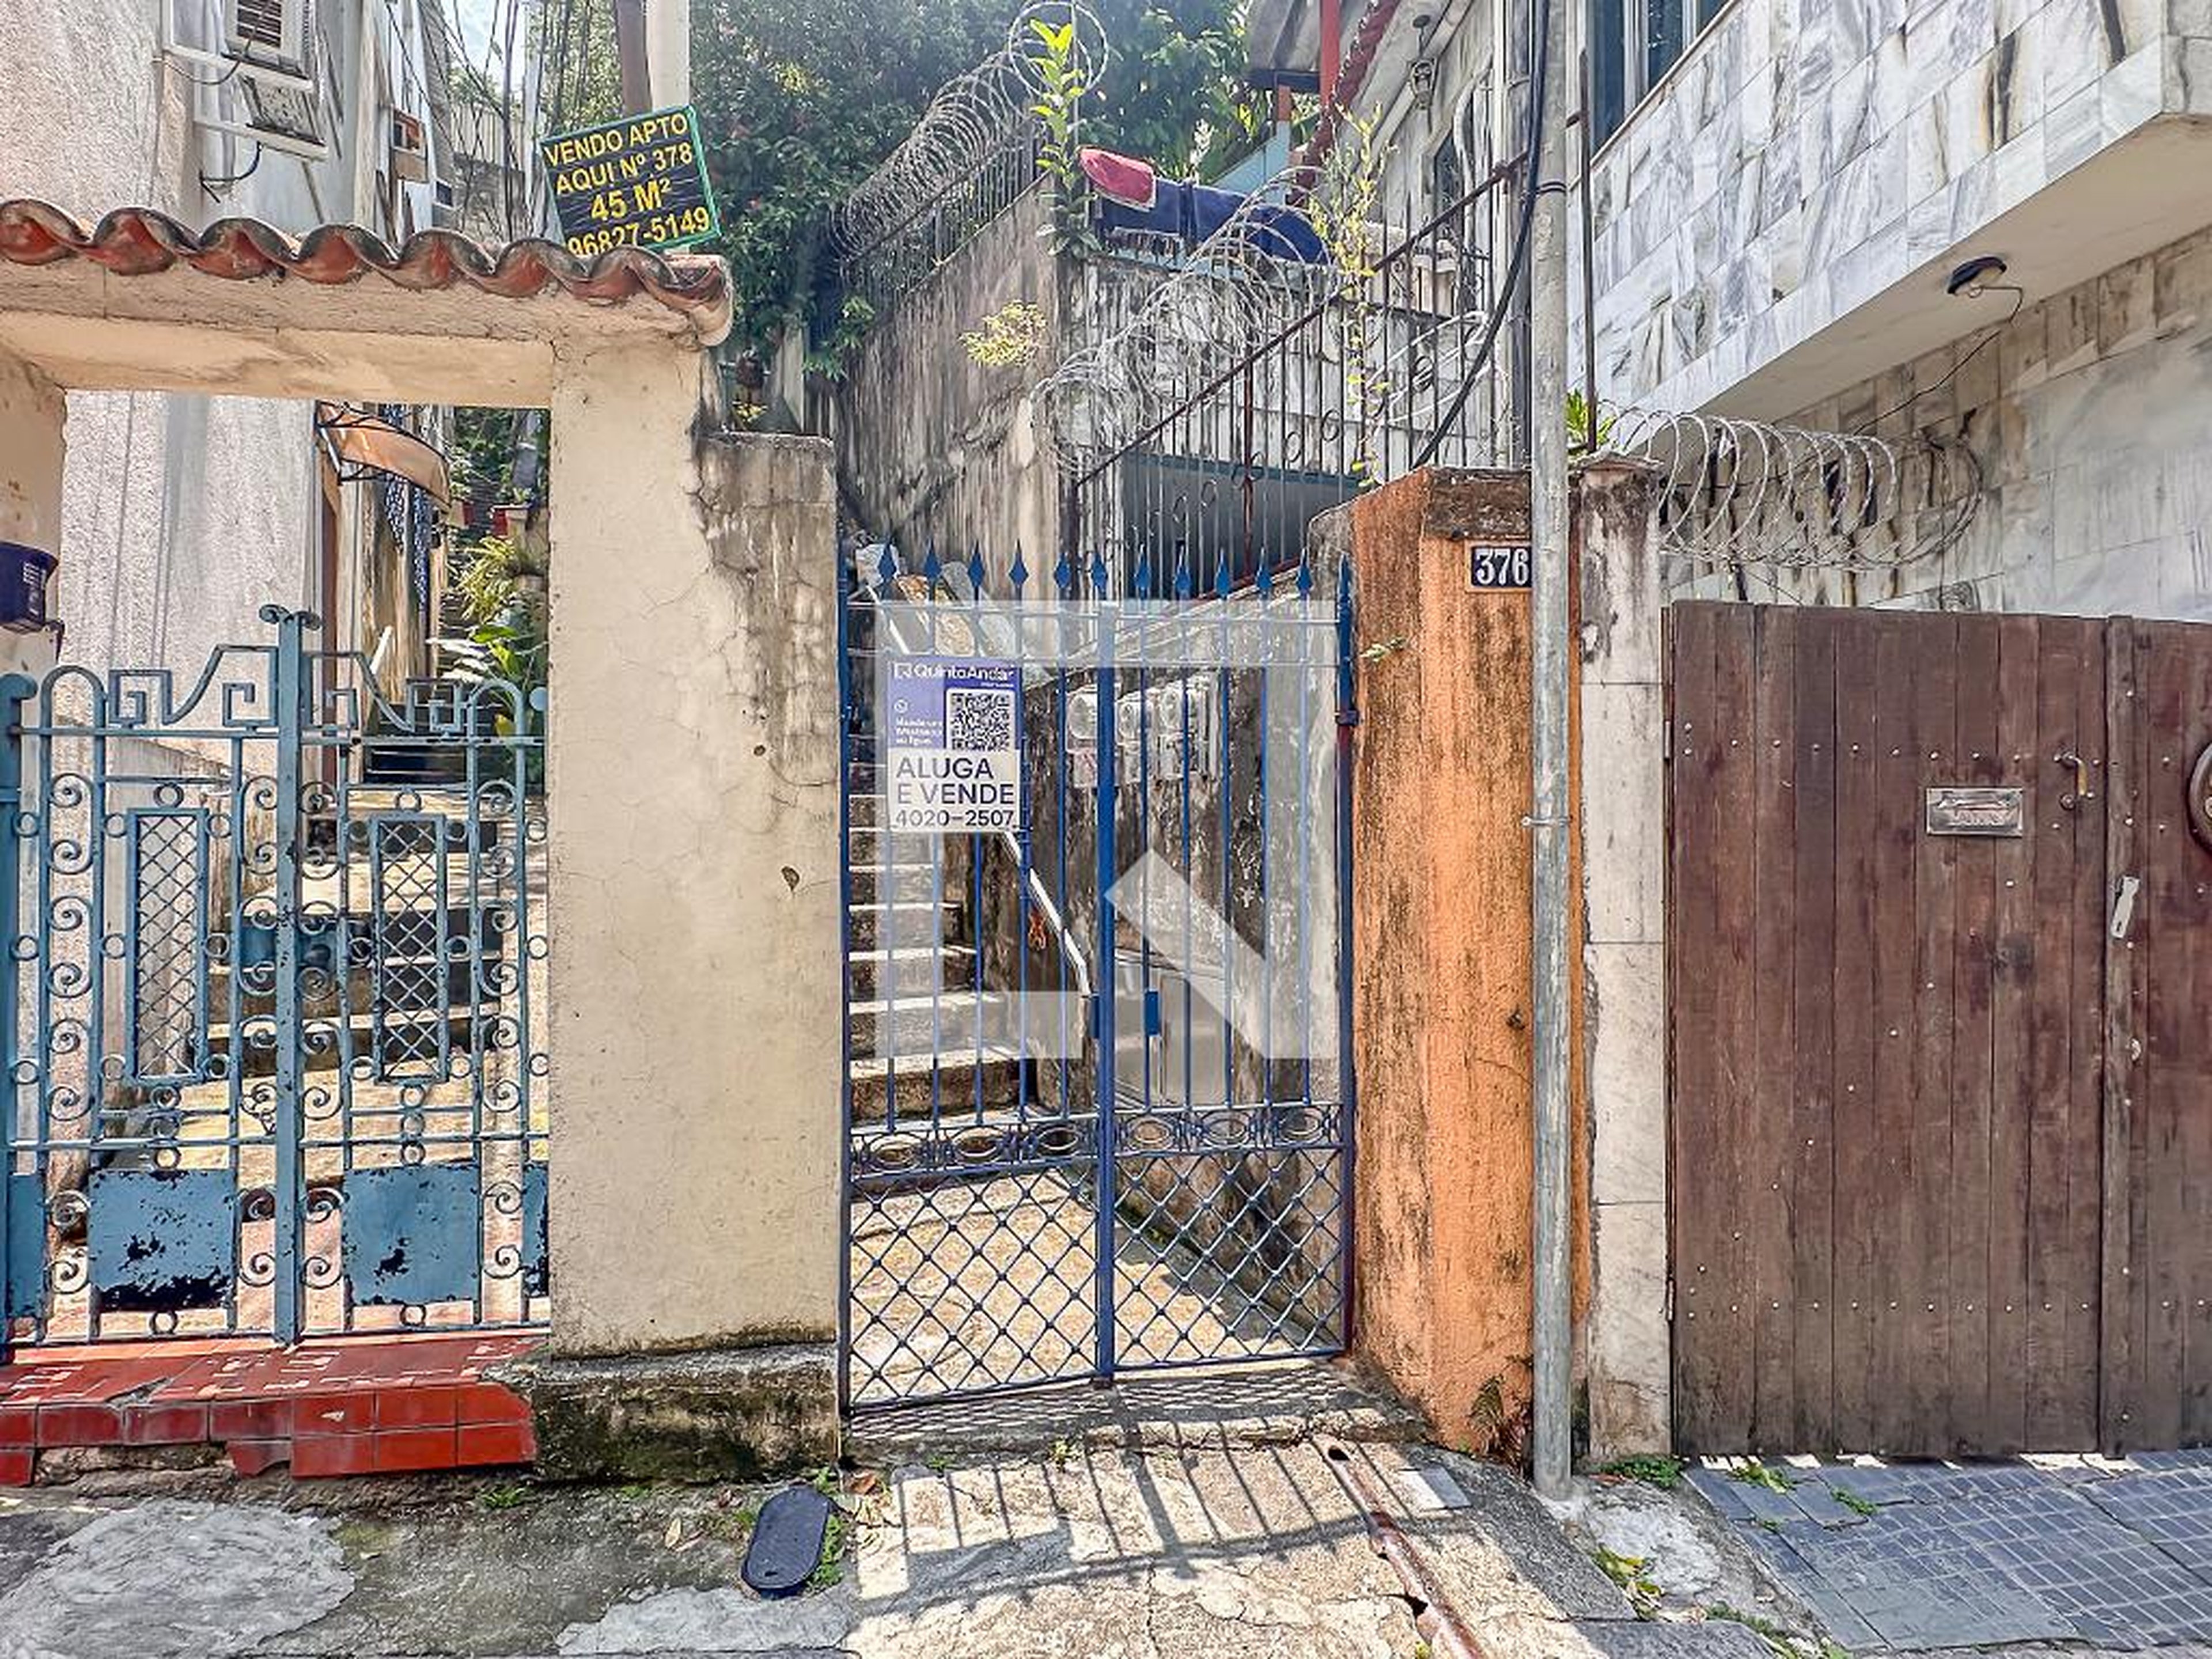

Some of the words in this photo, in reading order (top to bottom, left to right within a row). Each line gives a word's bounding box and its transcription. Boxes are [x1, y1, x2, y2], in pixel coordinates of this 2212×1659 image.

[545, 130, 623, 166] VENDO
[630, 113, 687, 147] APTO
[556, 162, 614, 195] AQUI
[653, 142, 693, 171] 378
[590, 190, 627, 221] 45
[1475, 548, 1529, 585] 376
[896, 757, 994, 779] ALUGA
[899, 784, 911, 804] E
[920, 783, 1014, 804] VENDE
[896, 810, 1014, 827] 4020-2507
